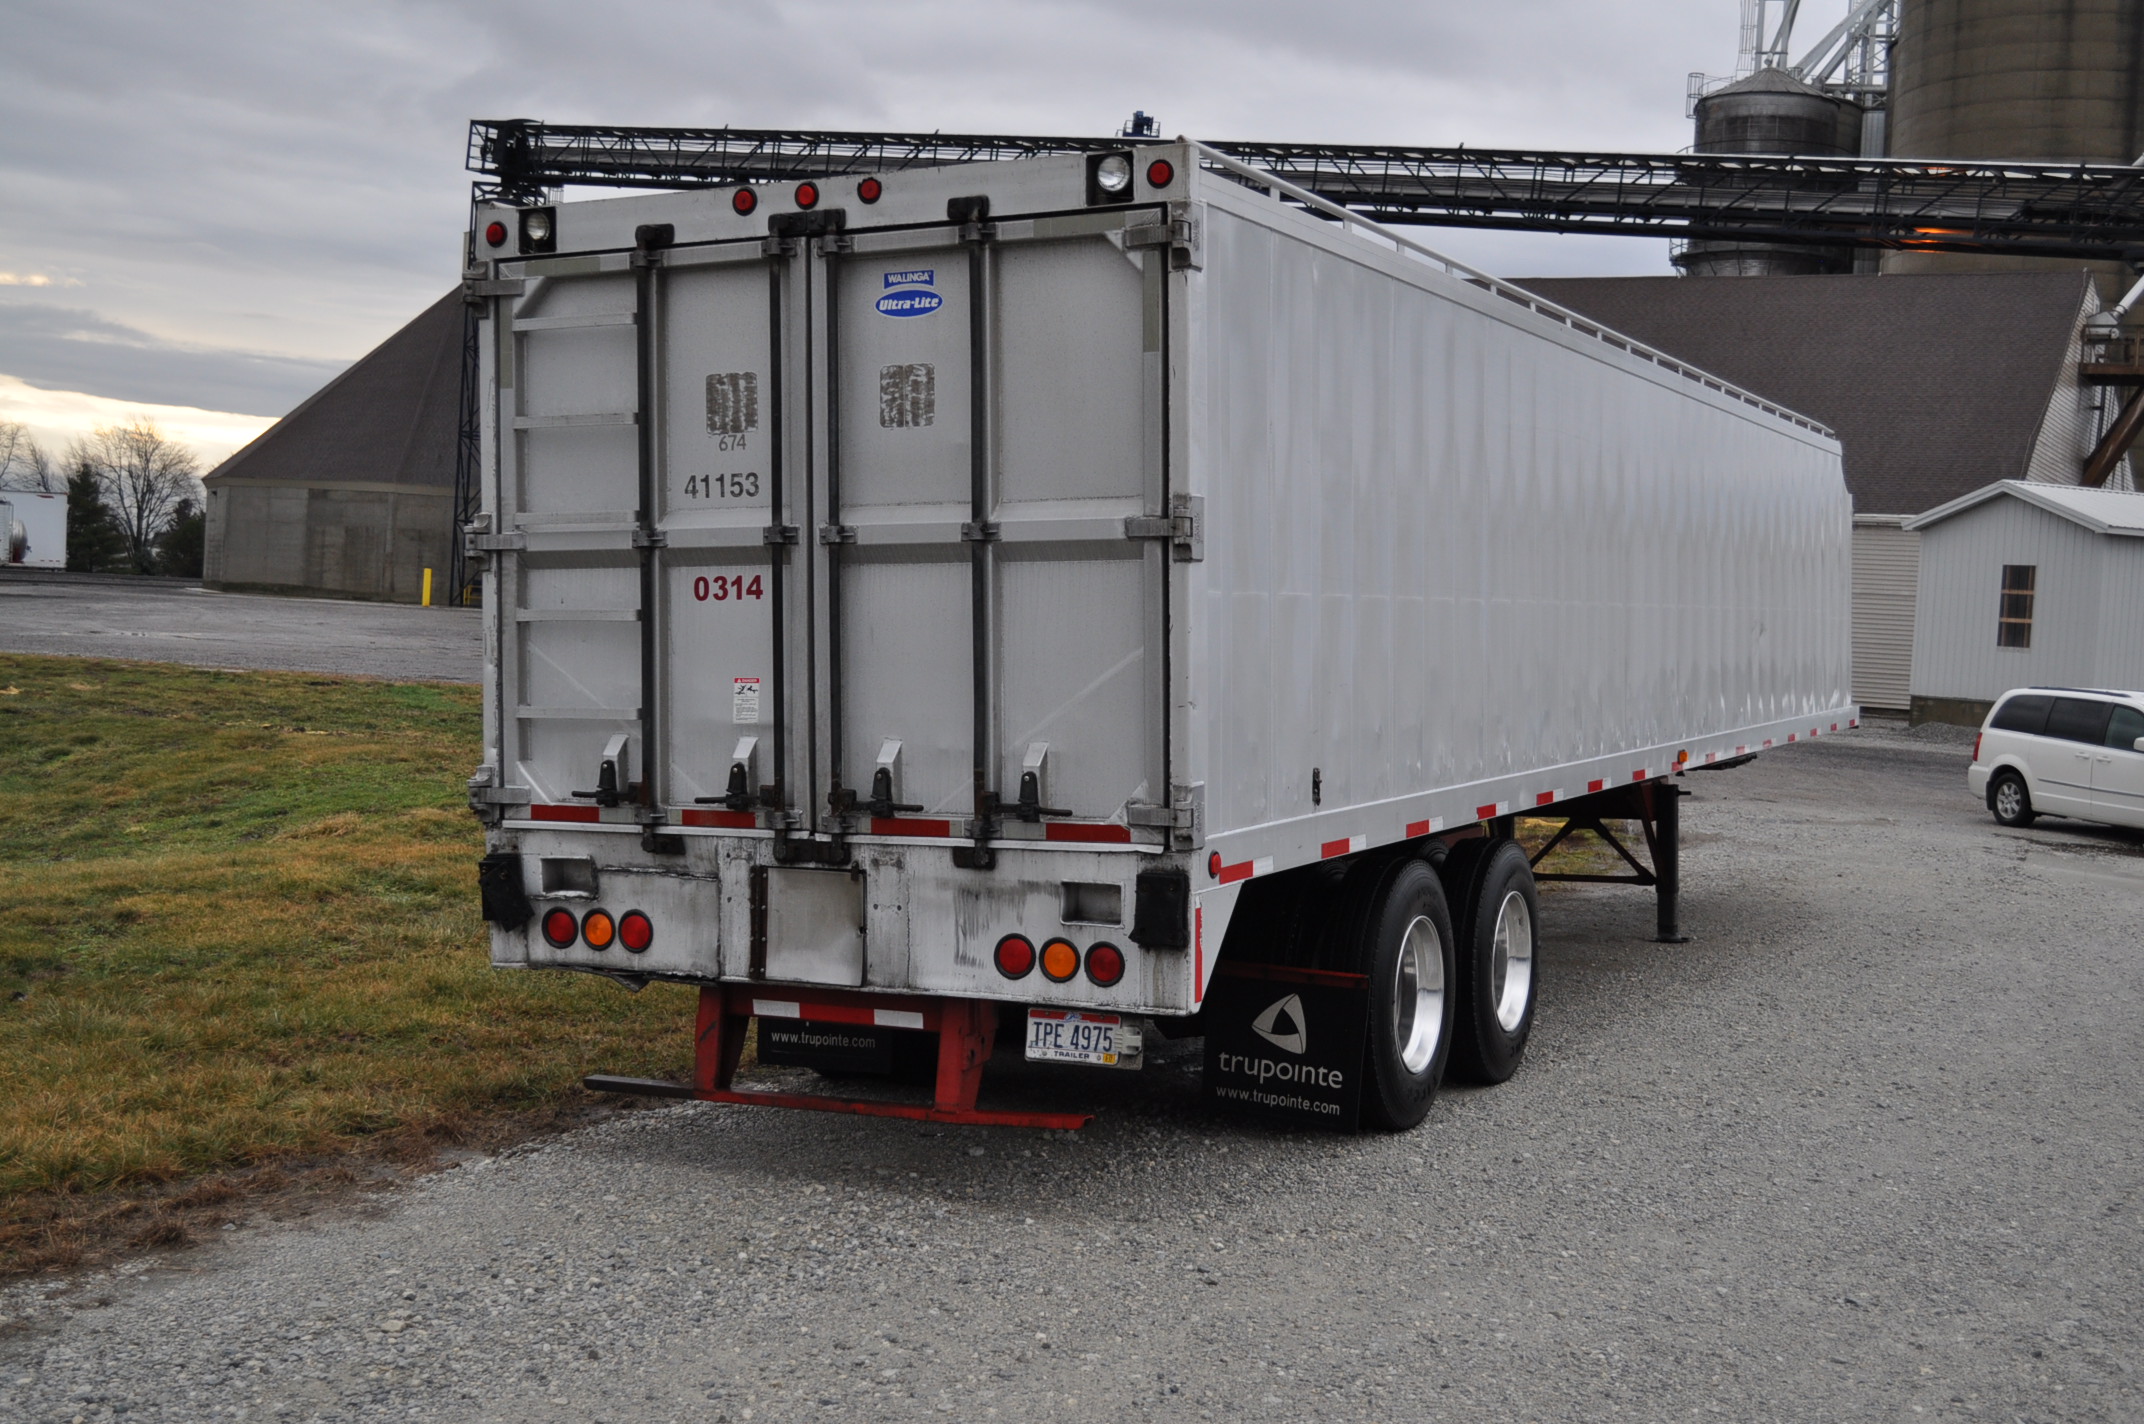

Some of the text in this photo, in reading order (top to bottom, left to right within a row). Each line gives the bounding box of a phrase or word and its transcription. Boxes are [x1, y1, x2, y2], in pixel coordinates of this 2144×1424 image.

[879, 297, 940, 311] Ultra-Lite
[718, 434, 747, 452] 674
[684, 472, 760, 499] 41153
[694, 575, 763, 601] 0314
[771, 1032, 875, 1048] www.trupointe.com
[1033, 1022, 1114, 1052] TPE 4975
[1054, 1050, 1090, 1059] TRAILER
[1219, 1051, 1343, 1089] trupointe
[1216, 1086, 1340, 1115] www.trupointe.com
